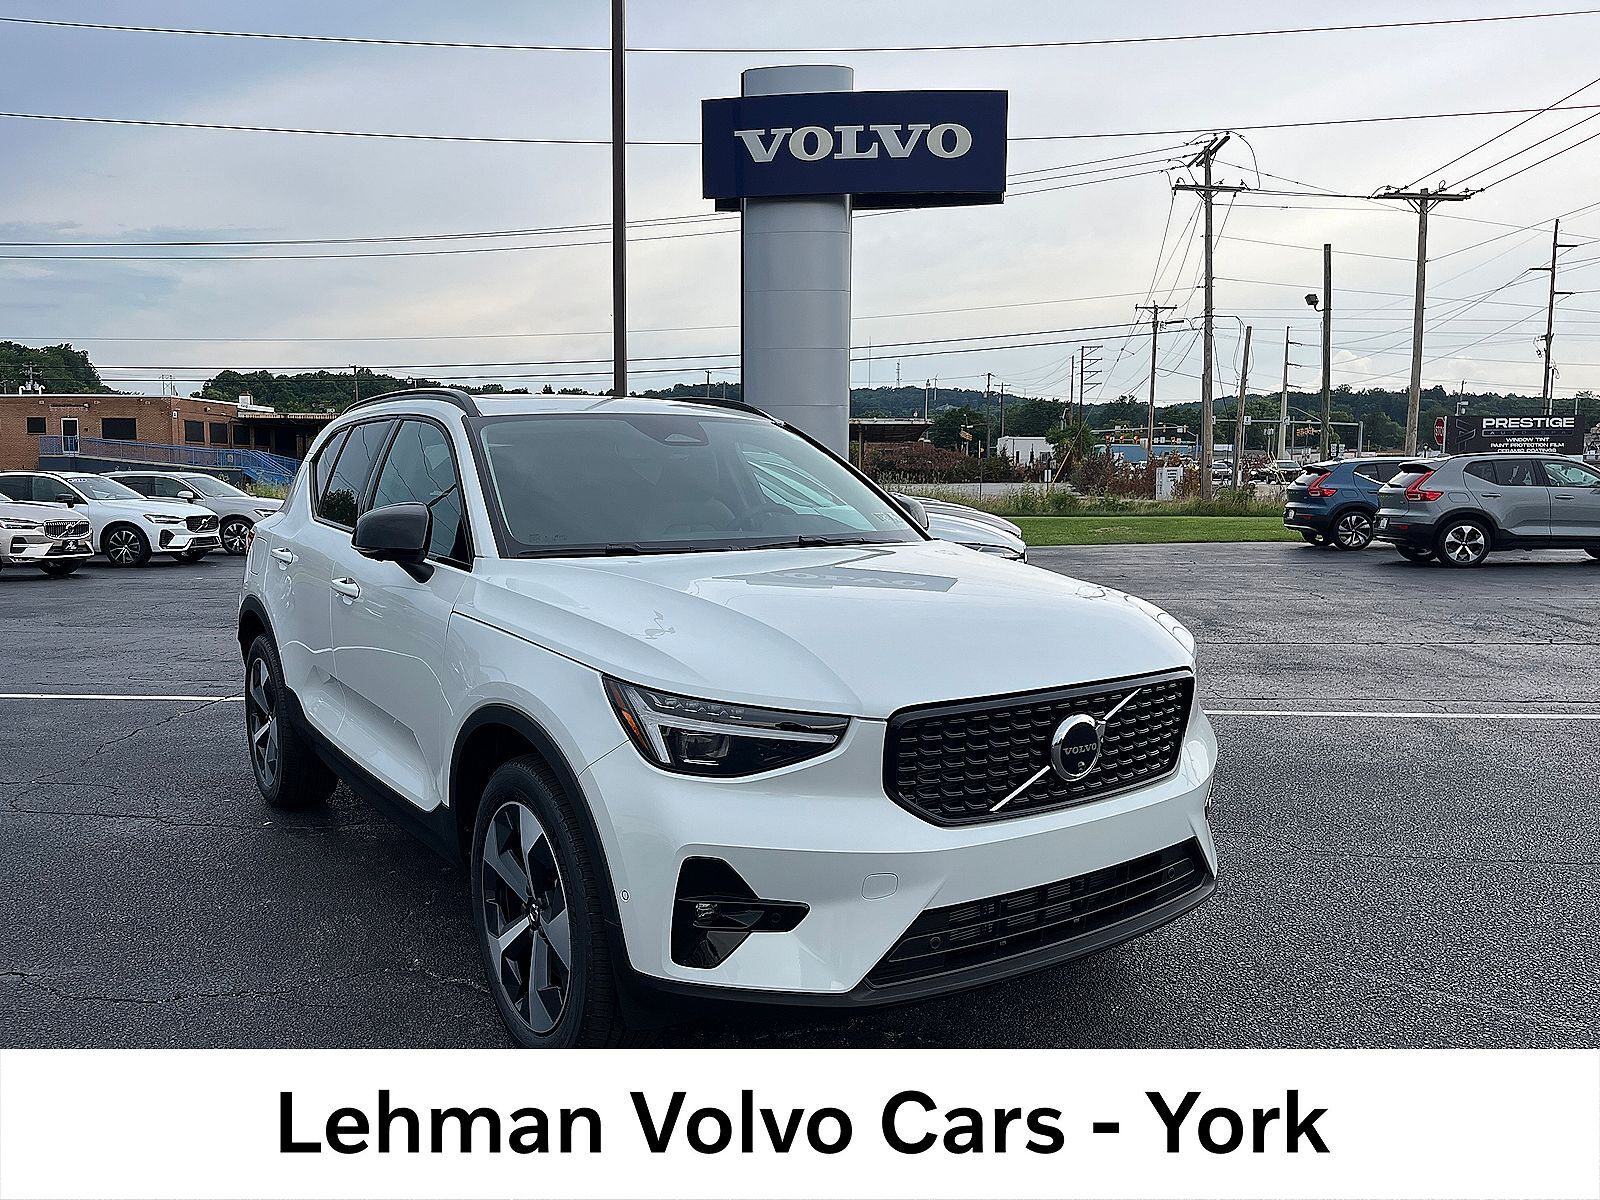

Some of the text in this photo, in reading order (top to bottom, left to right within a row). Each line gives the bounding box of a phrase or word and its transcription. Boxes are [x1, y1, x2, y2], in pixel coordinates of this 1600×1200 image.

[733, 123, 973, 163] VOLVO
[1482, 417, 1575, 428] PRESTIGE
[1063, 742, 1097, 755] VOLVO
